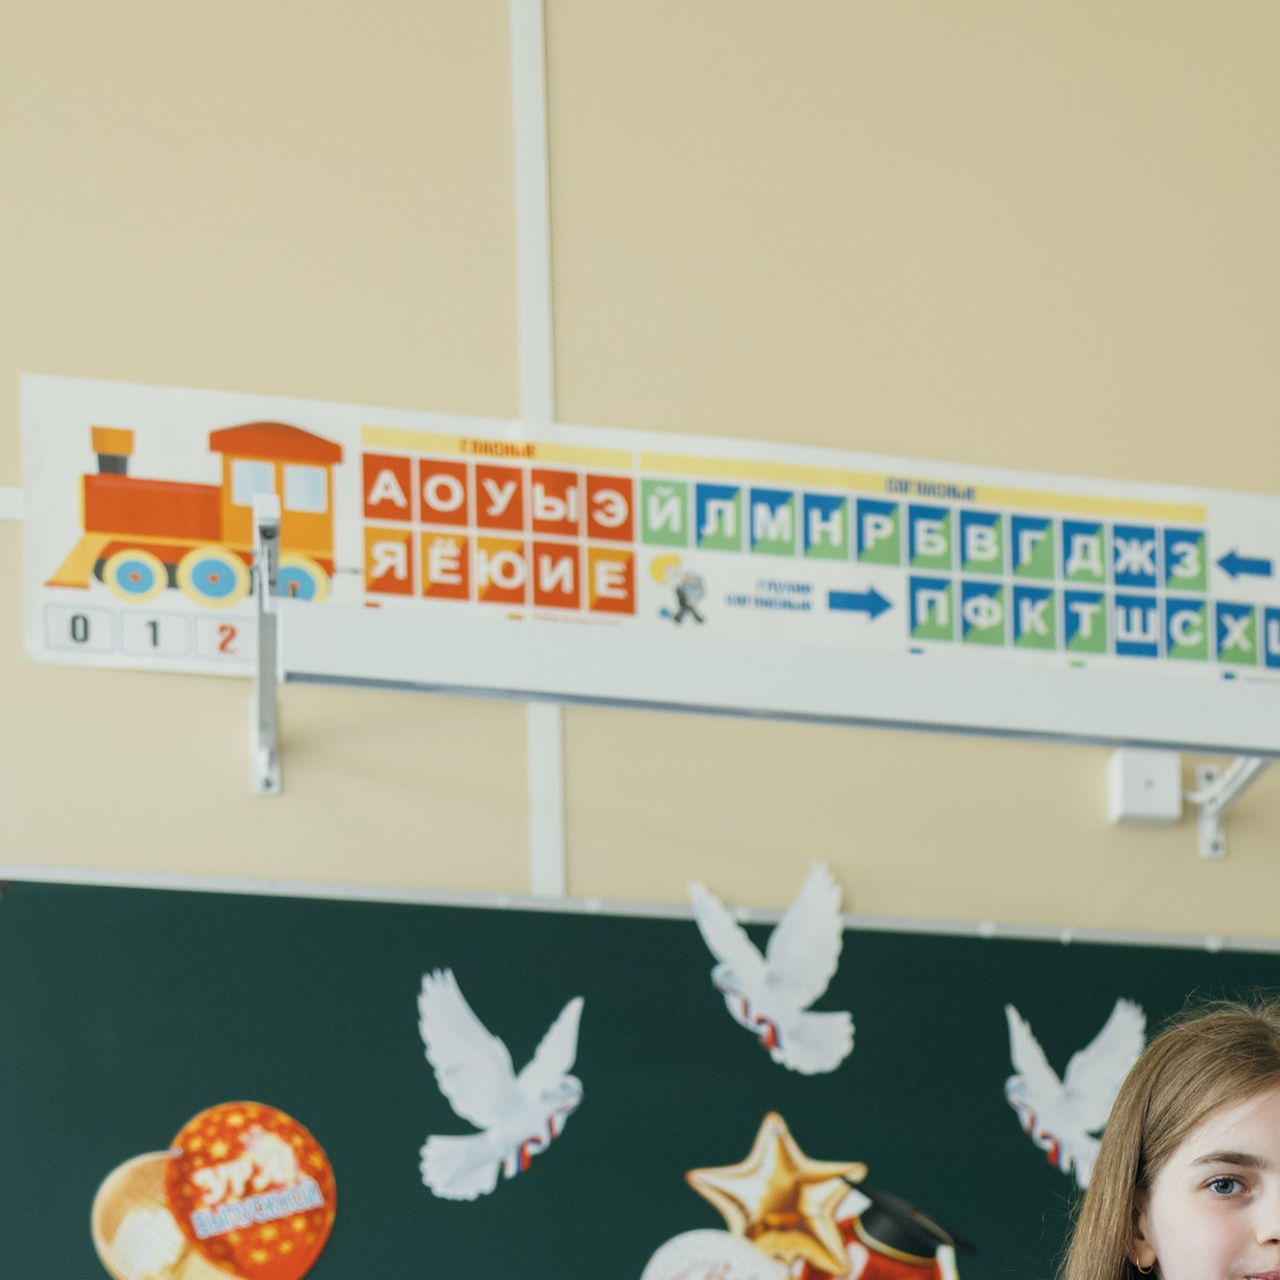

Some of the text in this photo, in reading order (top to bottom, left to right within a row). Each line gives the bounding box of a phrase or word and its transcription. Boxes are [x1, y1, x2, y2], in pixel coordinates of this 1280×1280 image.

[71, 614, 239, 654] 0 1 2
